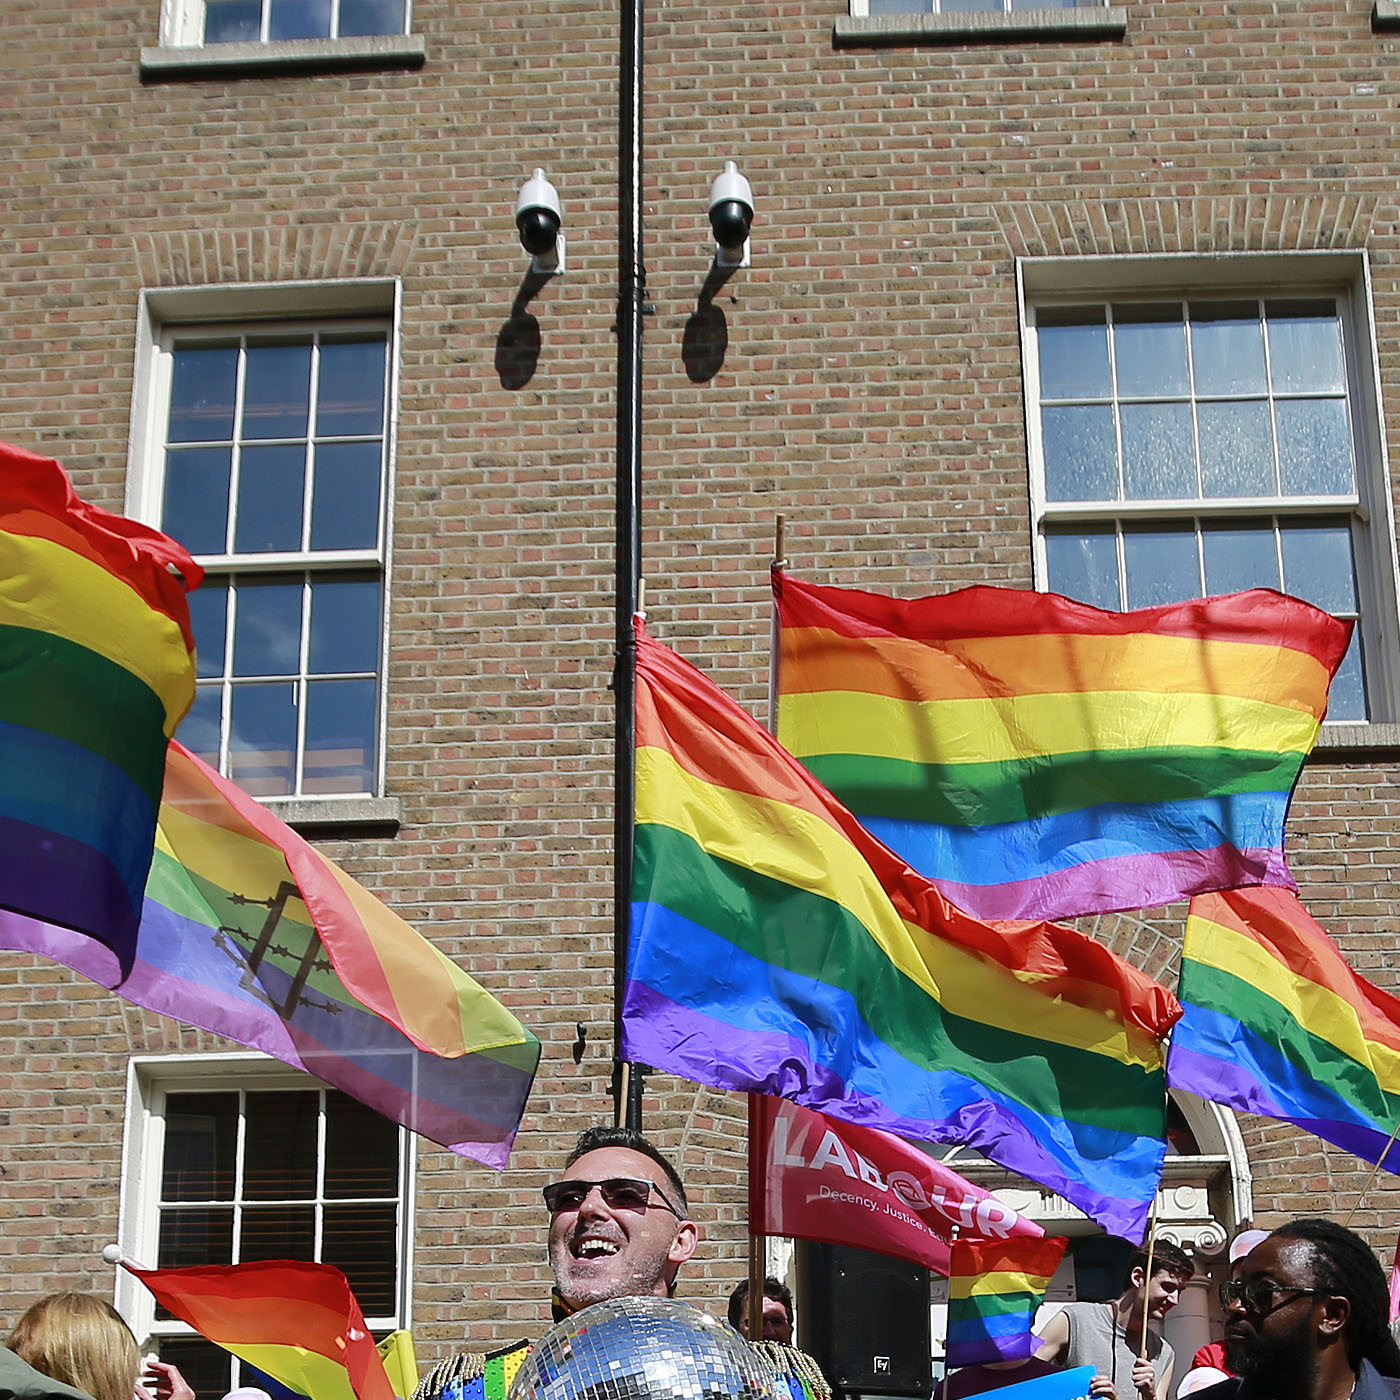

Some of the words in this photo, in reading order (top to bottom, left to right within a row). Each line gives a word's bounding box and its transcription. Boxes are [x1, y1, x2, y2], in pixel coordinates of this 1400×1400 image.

[773, 1116, 1019, 1240] LABOUR
[819, 1185, 880, 1212] Decency.
[882, 1202, 927, 1233] Justice.
